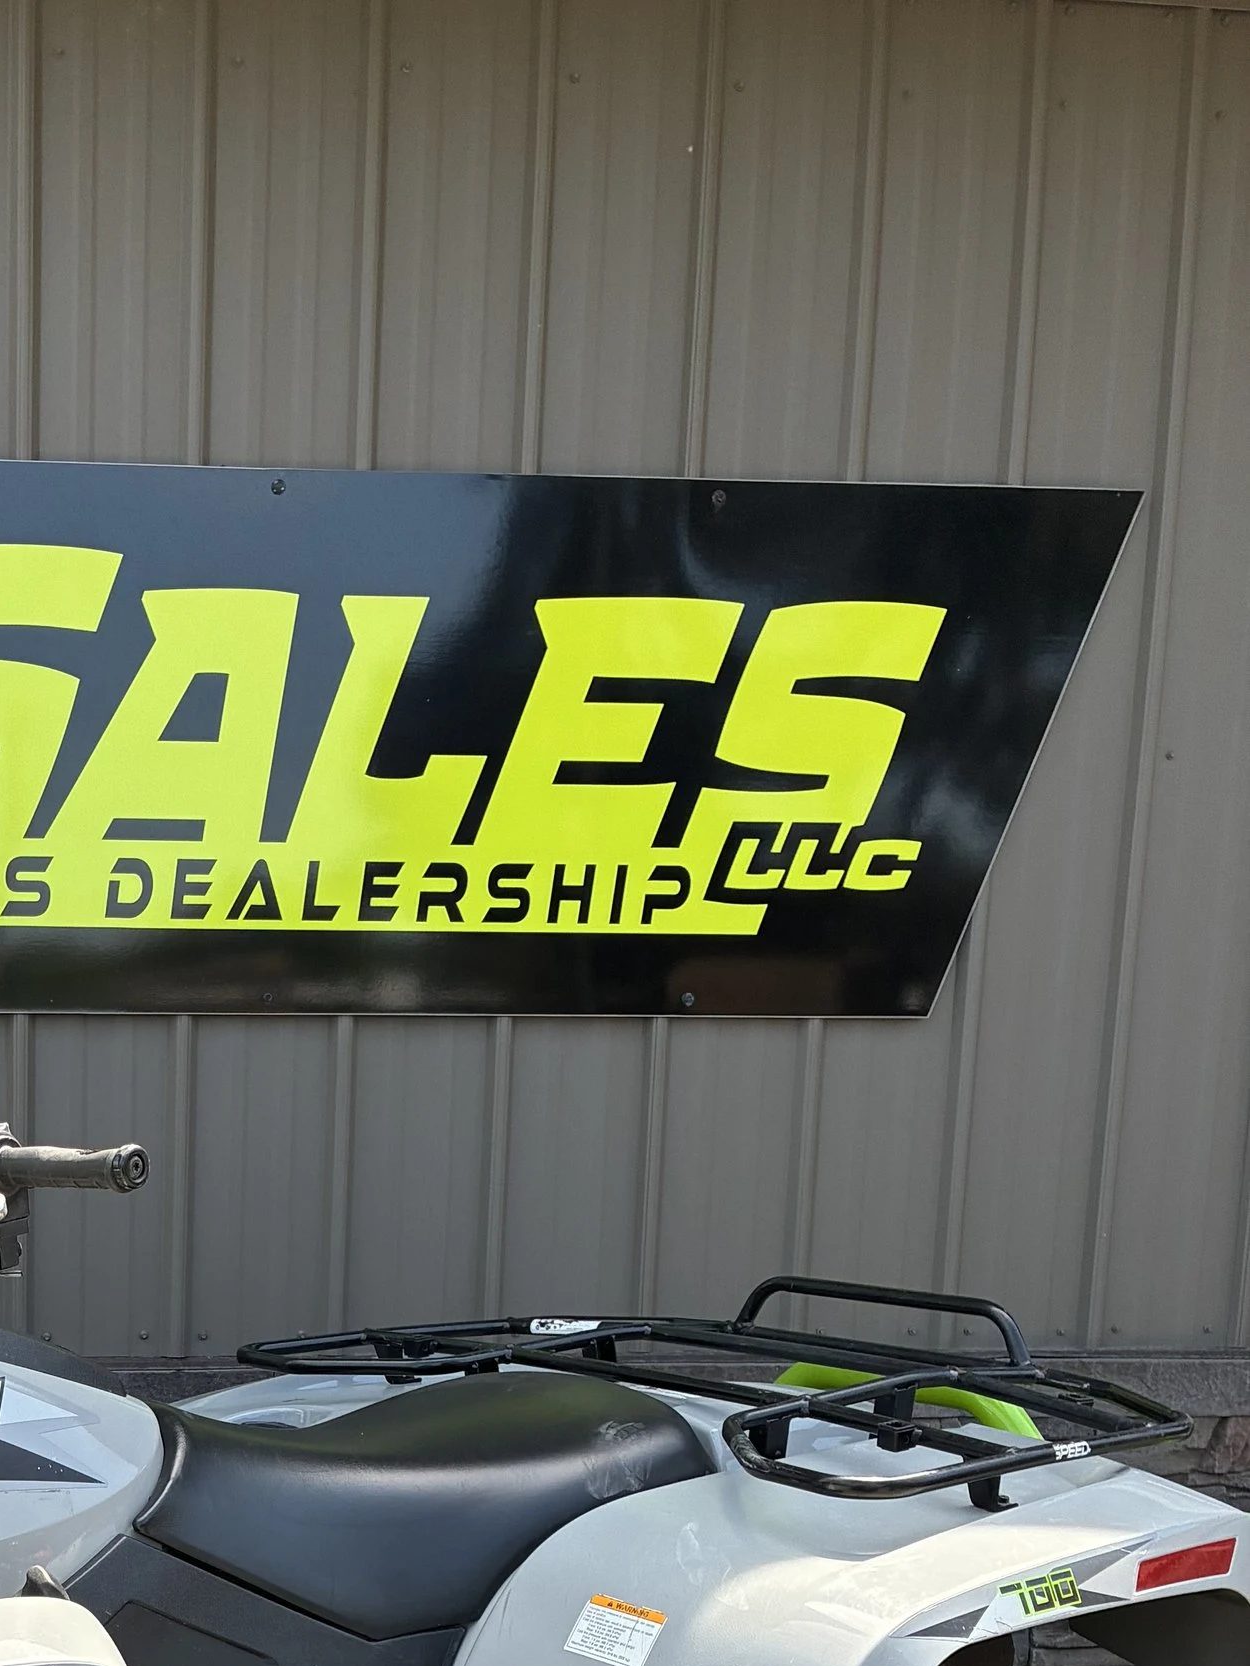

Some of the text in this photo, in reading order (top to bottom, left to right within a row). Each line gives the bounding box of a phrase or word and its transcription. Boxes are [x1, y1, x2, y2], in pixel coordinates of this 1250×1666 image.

[105, 855, 692, 925] DEALERSHIP
[726, 838, 923, 891] LLC
[998, 1568, 1082, 1616] 700
